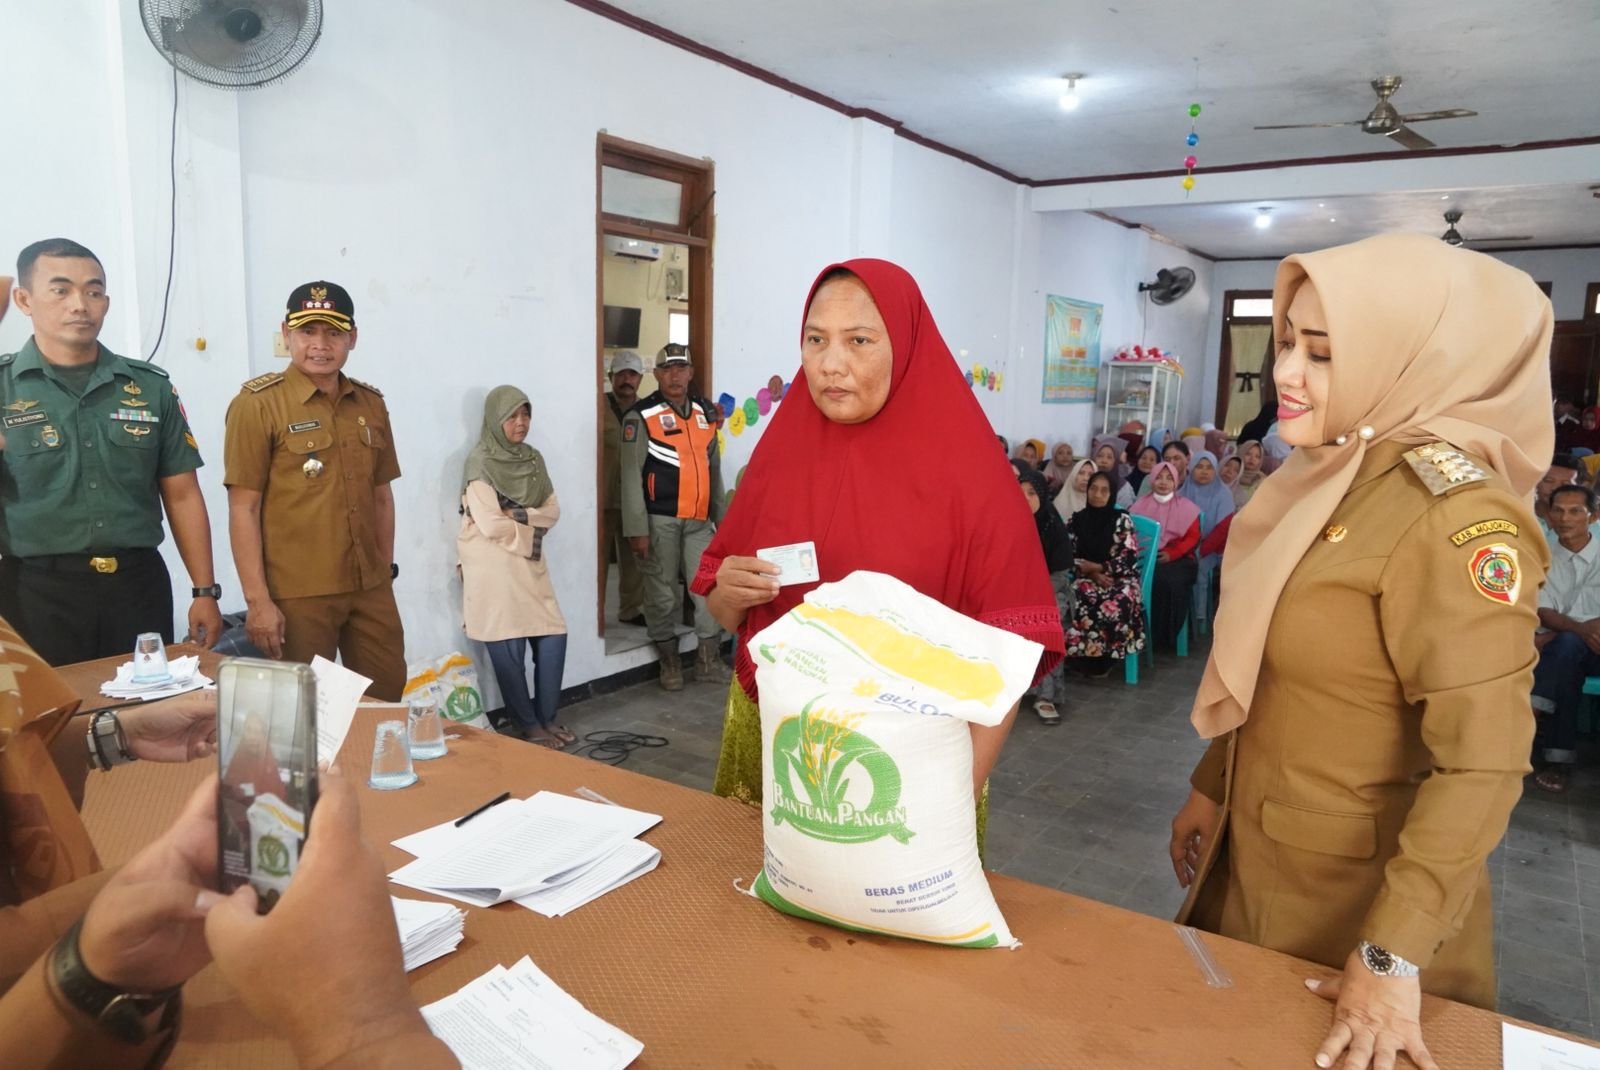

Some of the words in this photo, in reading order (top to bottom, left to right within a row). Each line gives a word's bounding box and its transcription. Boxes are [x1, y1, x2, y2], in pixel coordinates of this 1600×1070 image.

[1455, 529, 1476, 544] KAB.
[773, 780, 834, 824] BANTUAN
[836, 801, 906, 827] PANGAN
[864, 886, 905, 897] BERAS
[907, 869, 953, 893] MEDIUM
